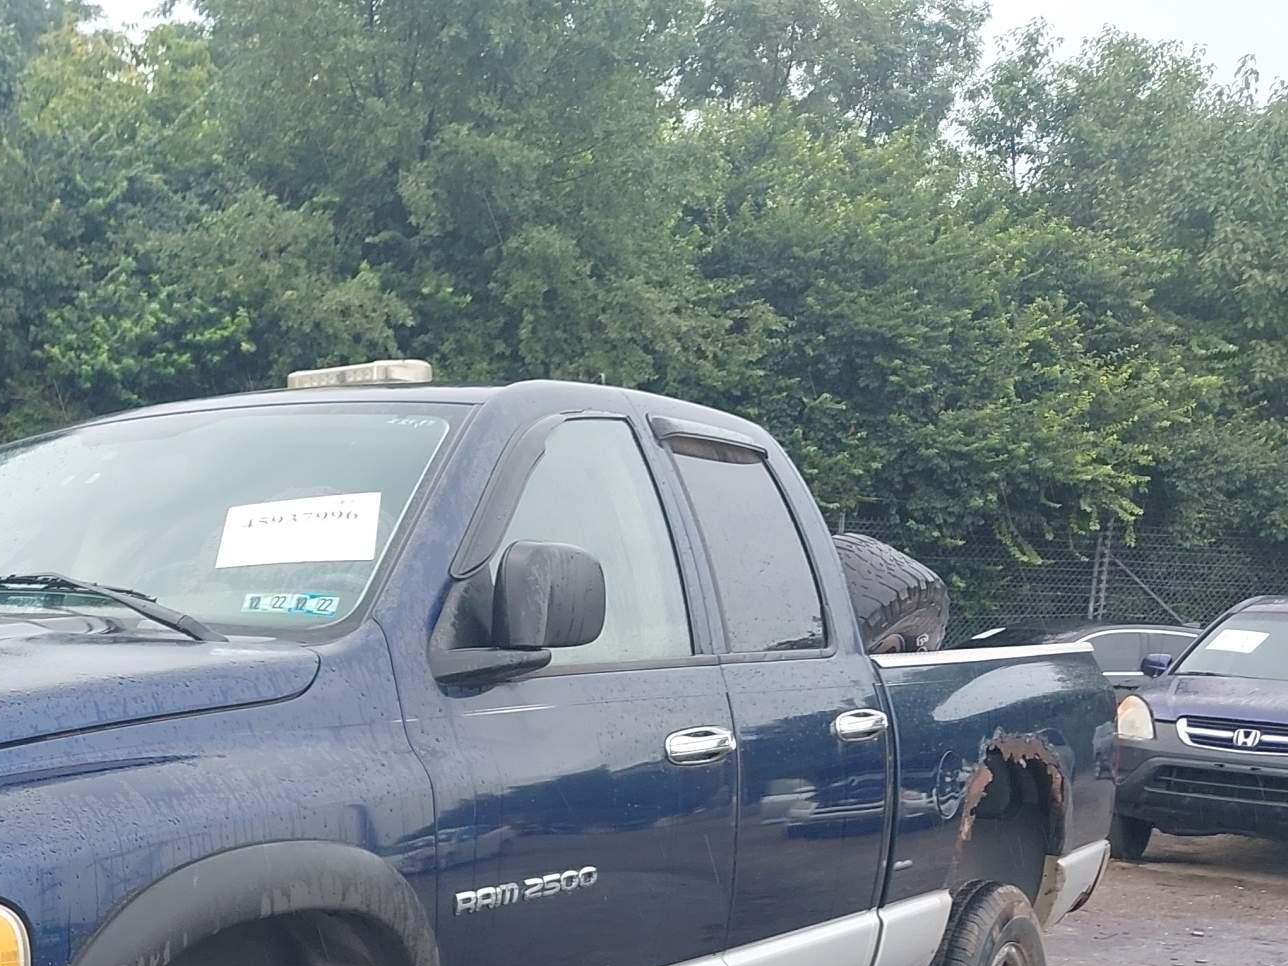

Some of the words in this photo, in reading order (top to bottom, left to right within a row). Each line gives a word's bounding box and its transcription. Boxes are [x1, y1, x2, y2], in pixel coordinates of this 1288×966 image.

[272, 596, 287, 609] 22
[317, 598, 333, 611] 22
[455, 882, 519, 915] RAM
[524, 866, 598, 898] 2500
